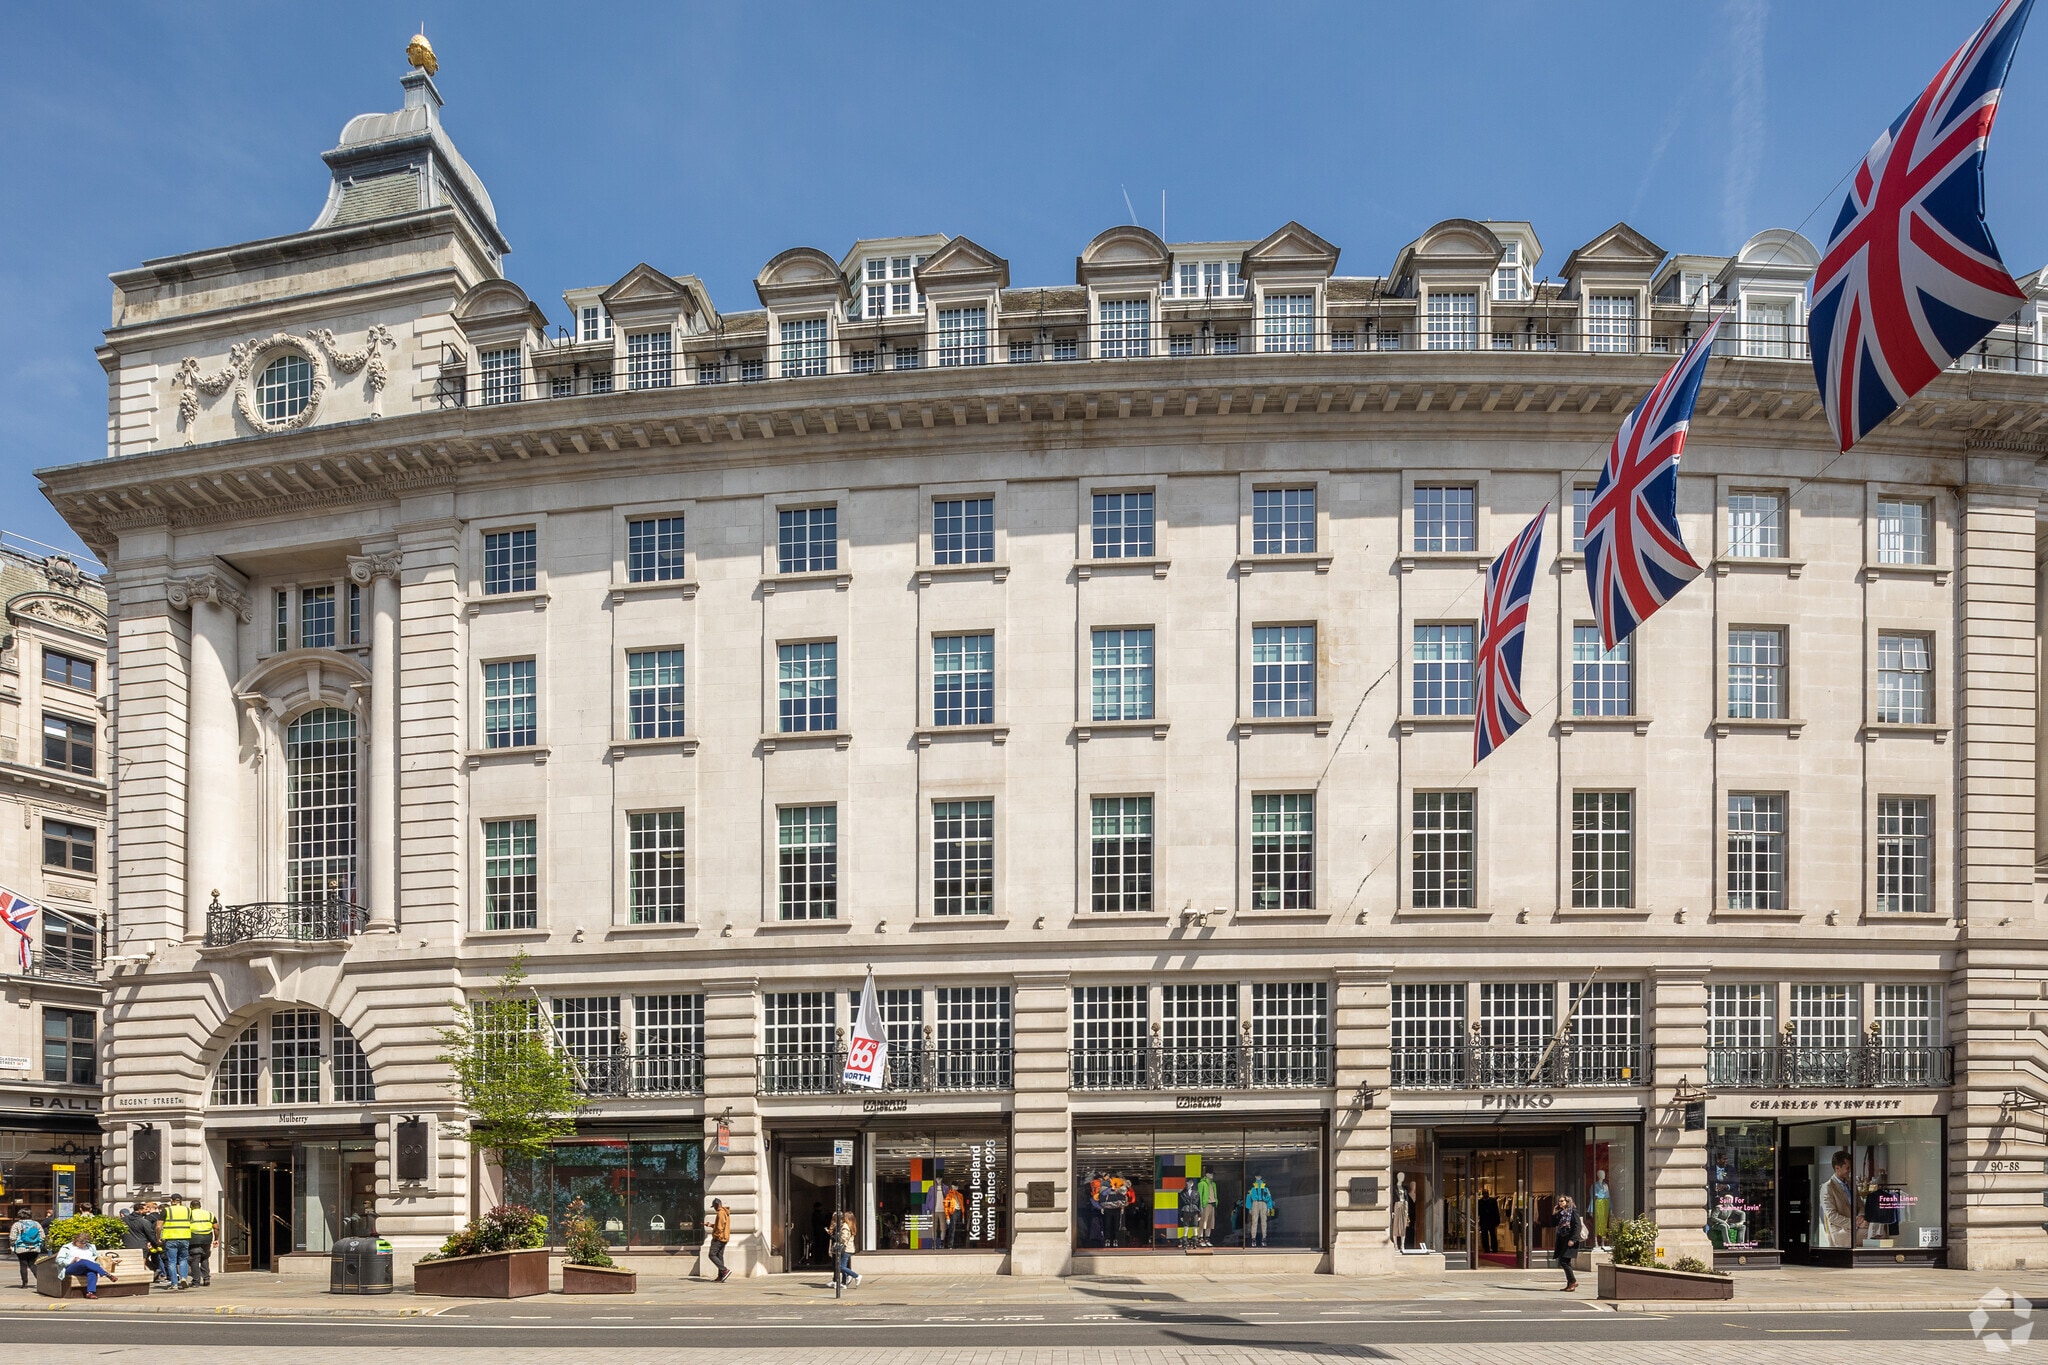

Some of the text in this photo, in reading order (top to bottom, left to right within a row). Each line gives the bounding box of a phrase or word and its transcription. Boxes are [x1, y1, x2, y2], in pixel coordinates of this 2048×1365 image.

[29, 1096, 102, 1111] BALL
[120, 1099, 148, 1107] REGENT
[153, 1097, 179, 1105] STREET
[1481, 1094, 1554, 1109] PINKO
[1750, 1100, 1902, 1110] CHARLES TYRWHITT
[279, 1111, 309, 1124] Mulberry
[1990, 1161, 2020, 1172] 90-88
[969, 1145, 983, 1241] Keeping Iceland
[984, 1139, 996, 1241] warm since 1926
[1735, 1196, 1745, 1204] For
